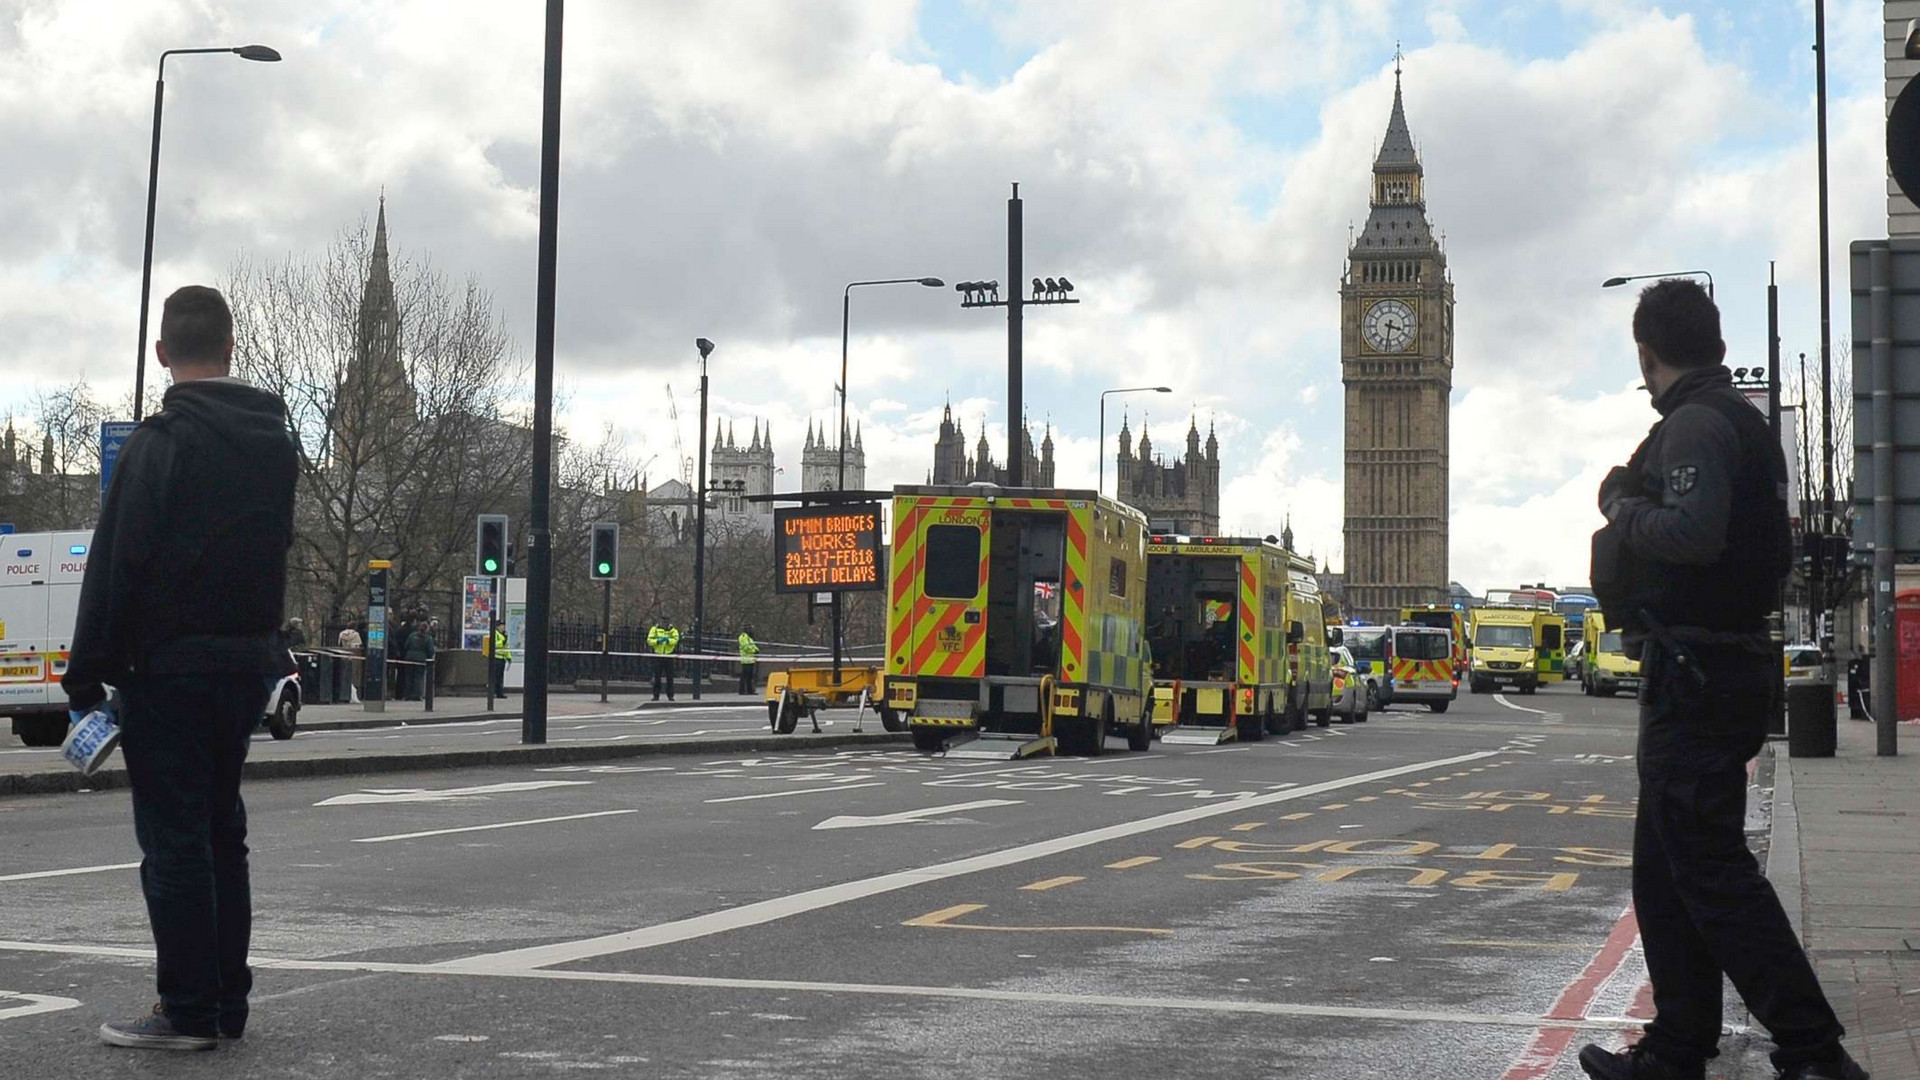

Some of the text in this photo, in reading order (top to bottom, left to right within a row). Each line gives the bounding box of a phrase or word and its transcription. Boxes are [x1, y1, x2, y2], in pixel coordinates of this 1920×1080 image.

[785, 515, 875, 535] W'MIN BRIDGES
[939, 515, 980, 524] LONDON
[802, 533, 856, 550] WORKS
[1185, 546, 1233, 554] AMBULANCE
[786, 549, 873, 568] 29.3.17-FEB18
[7, 562, 87, 575] POLICE POLIC
[786, 565, 876, 585] EXPECT DELAYS
[1212, 839, 1634, 867] STOP
[1184, 861, 1580, 892] BUS
